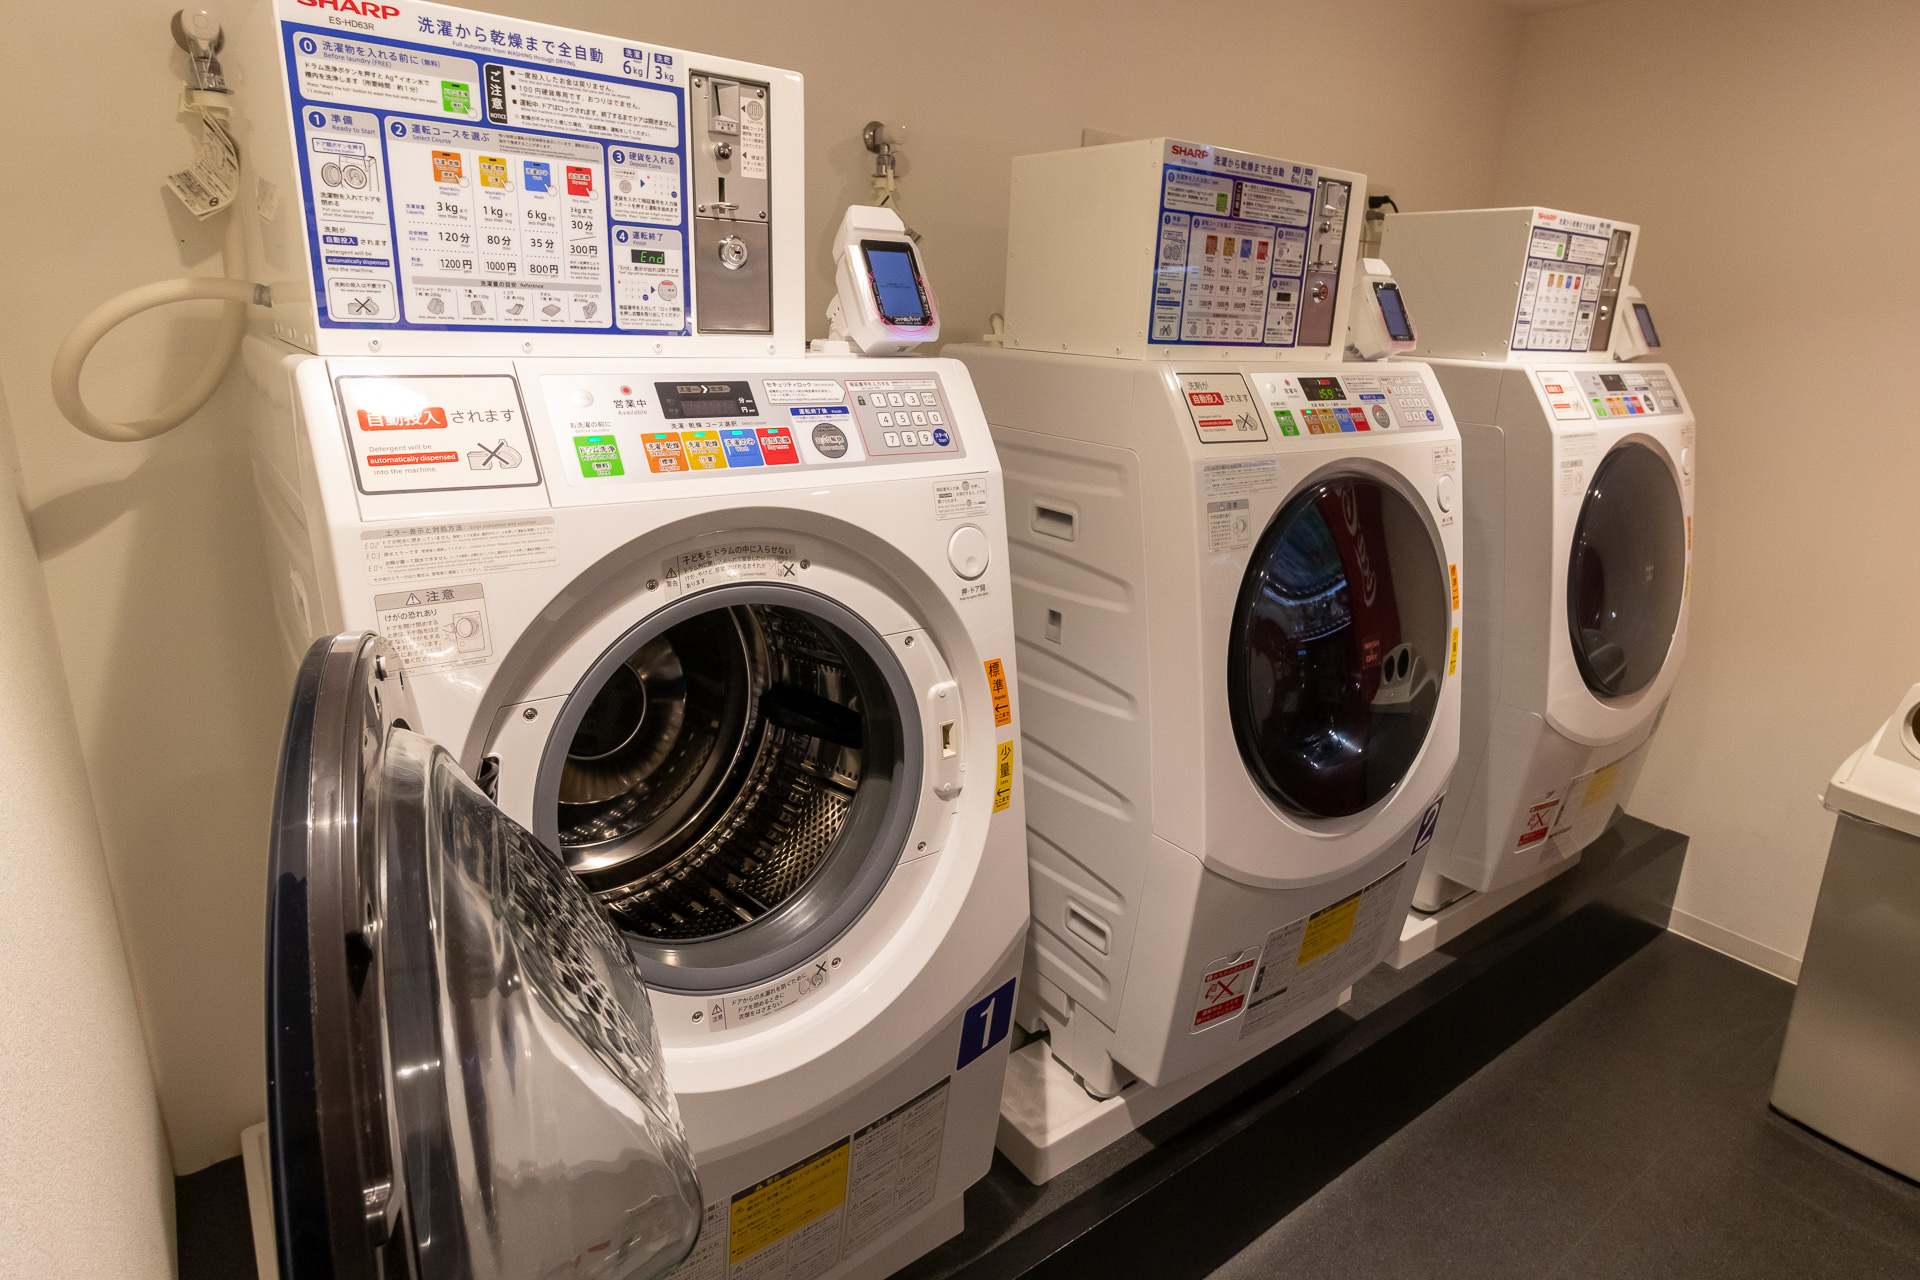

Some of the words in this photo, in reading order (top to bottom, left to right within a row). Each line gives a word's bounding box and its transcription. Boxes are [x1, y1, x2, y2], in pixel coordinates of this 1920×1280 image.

[329, 16, 375, 31] ES-HD63R
[418, 15, 603, 64] 洗濯から乾燥まで全自動
[323, 41, 419, 65] 洗濯物を入れる前に
[507, 50, 533, 60] WASHING
[324, 52, 345, 61] Before
[347, 55, 371, 66] laundry
[372, 58, 391, 68] (FREE)
[331, 113, 353, 125] 準備
[332, 125, 351, 133] Ready
[412, 123, 490, 142] 運転コースを選ぶ
[431, 136, 451, 144] Course
[1171, 145, 1209, 159] SHARP
[629, 152, 675, 165] 硬貨を入れる
[1213, 155, 1285, 178] 洗濯から乾燥まで全自動
[1538, 212, 1557, 221] SHARP
[324, 226, 346, 234] 洗剤が
[326, 236, 355, 245] 自動投入
[632, 231, 663, 241] 運転終了
[326, 248, 352, 256] Detergent
[570, 245, 598, 255] 300円
[328, 257, 361, 265] automatically
[362, 259, 388, 267] dispensed
[640, 251, 664, 264] End
[440, 258, 472, 270] 1200円
[486, 261, 517, 273] 1000円
[529, 264, 559, 275] 800円
[1187, 382, 1209, 390] 洗剤が
[613, 399, 647, 409] 営業中
[1191, 395, 1222, 404] 自動投入
[1224, 394, 1248, 403] されます
[450, 409, 515, 424] されます
[883, 416, 888, 424] 4
[901, 415, 906, 423] 5
[917, 415, 922, 423] 6
[726, 438, 755, 446] 洗濯のみ
[761, 436, 791, 445] 追加乾燥
[907, 435, 912, 443] 8
[923, 434, 928, 442] 9
[369, 444, 407, 453] Detergent
[370, 455, 419, 465] automatically
[420, 453, 456, 462] dispensed
[385, 525, 463, 537] エラー表示と対処方法
[365, 542, 379, 550] E02
[683, 545, 792, 565] 子どもをドラムの中に入らせない
[368, 564, 383, 572] E04
[426, 589, 455, 602] 注意
[385, 608, 437, 622] けがの恐れあり
[387, 620, 439, 631] ドアを開け閉めする
[1364, 640, 1379, 649] WASH
[1366, 653, 1377, 662] DRY
[989, 661, 1003, 693] 標準
[1000, 745, 1011, 779] 少量
[1415, 803, 1439, 851] 2
[731, 972, 808, 1006] ドアからの水漏れを防ぐために
[738, 992, 784, 1013] ドアを閉めるときに
[739, 1001, 784, 1020] 衣類をはさまない
[712, 1015, 723, 1023] 注意
[981, 997, 995, 1049] 1
